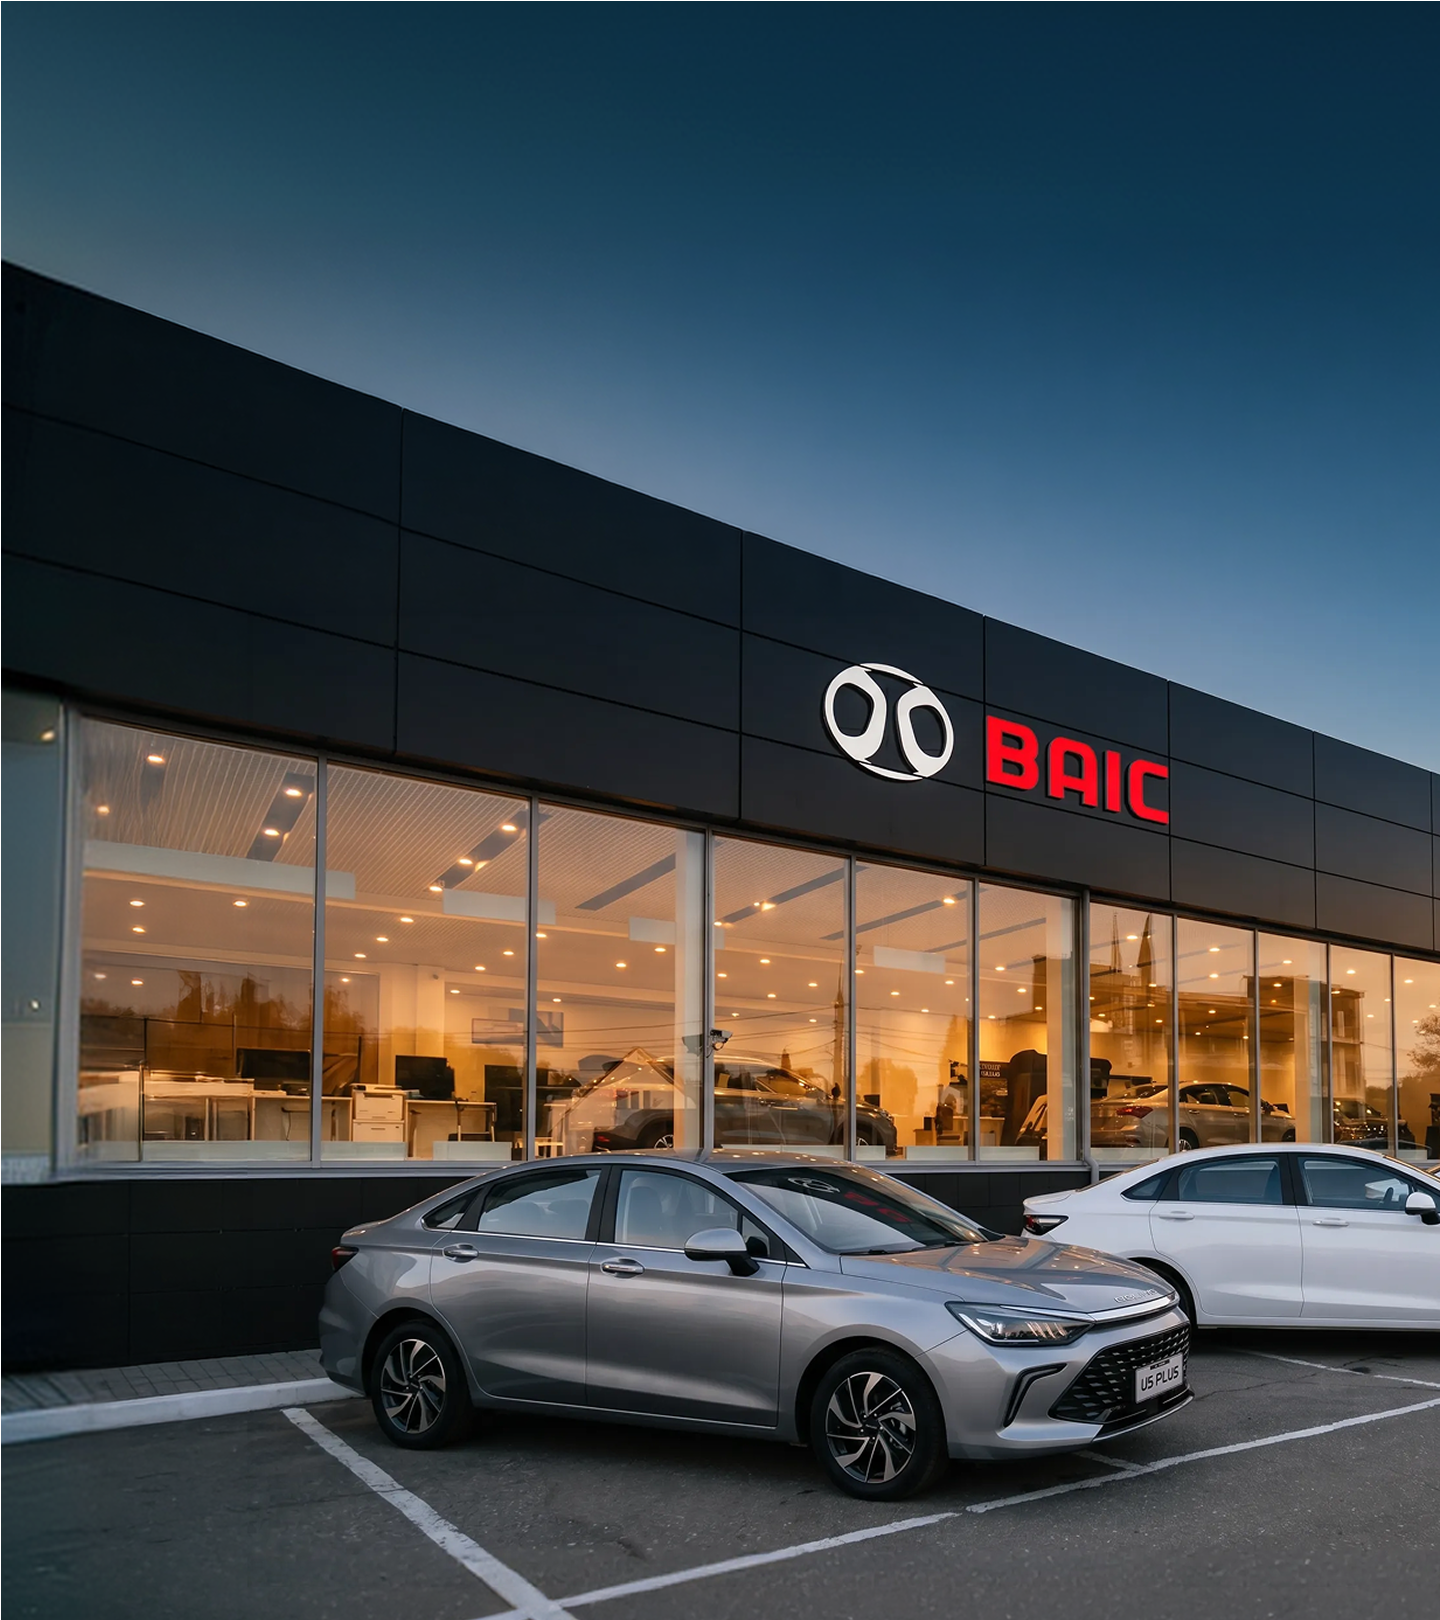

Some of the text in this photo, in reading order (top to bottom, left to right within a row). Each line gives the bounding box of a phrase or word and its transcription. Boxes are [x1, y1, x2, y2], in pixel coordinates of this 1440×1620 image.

[986, 714, 1169, 824] BAIC
[1141, 1365, 1179, 1391] U5 PLUS
